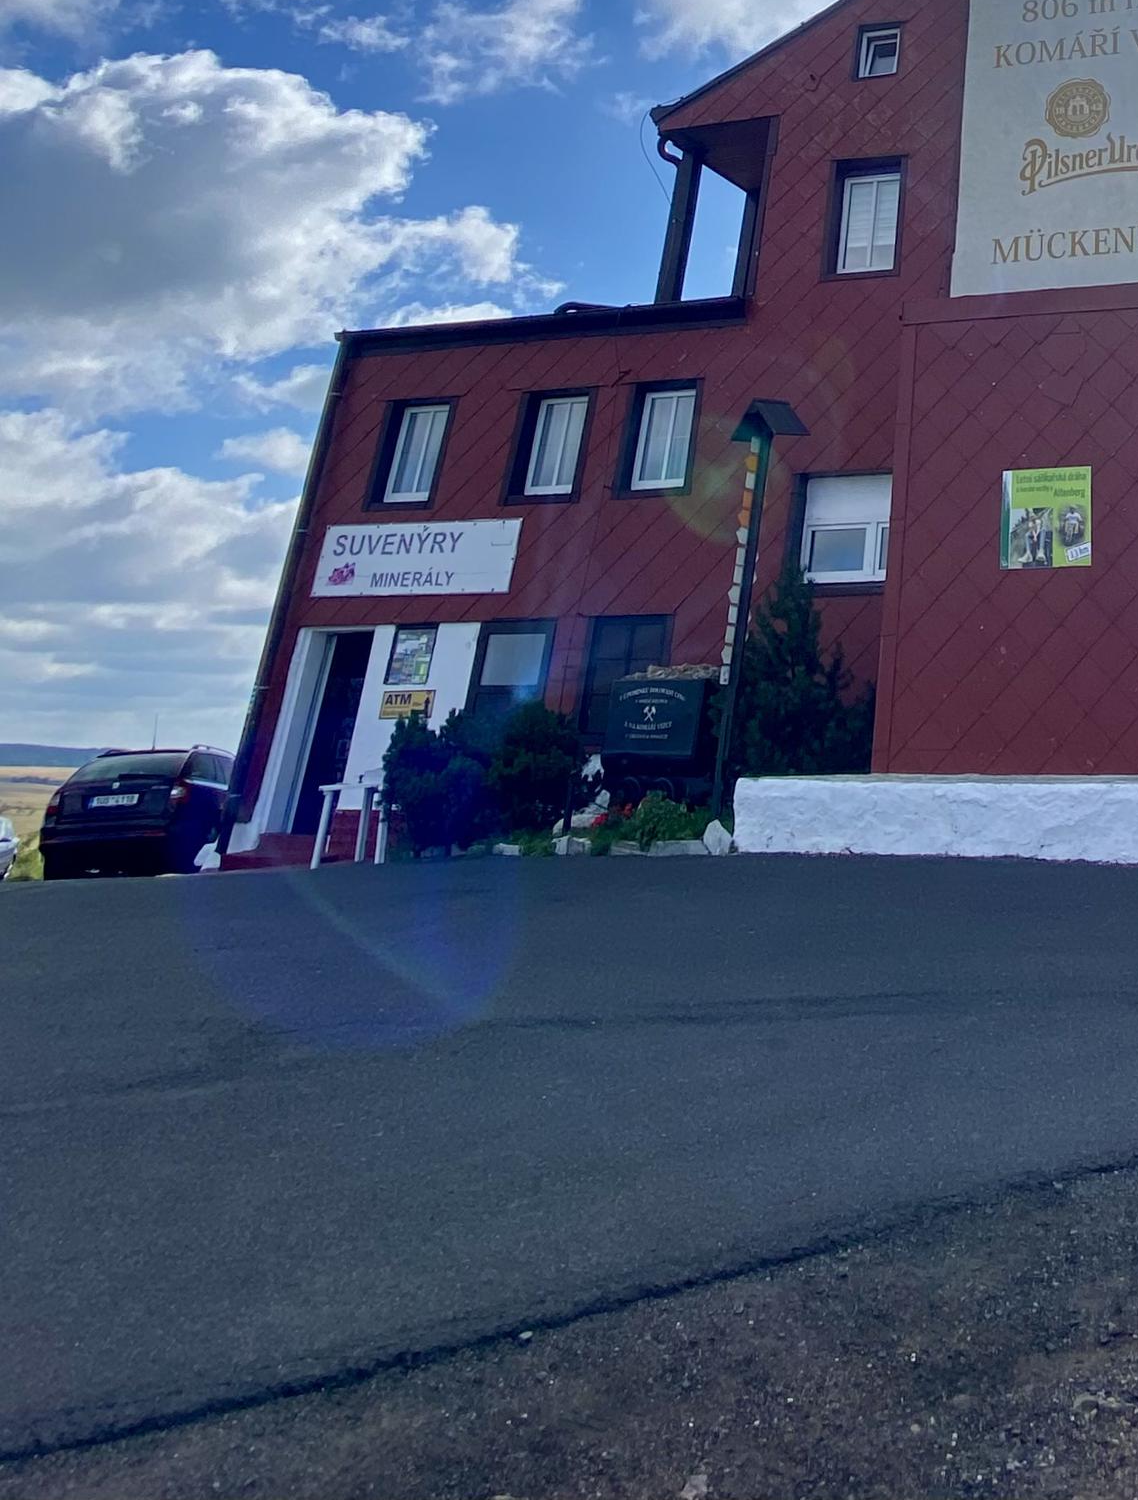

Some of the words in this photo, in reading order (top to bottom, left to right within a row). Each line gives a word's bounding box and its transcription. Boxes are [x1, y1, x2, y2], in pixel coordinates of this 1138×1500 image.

[994, 26, 1121, 69] KOMÁŘÍ
[1019, 137, 1108, 197] Pilsner
[333, 527, 463, 556] SUVENÝRY
[369, 567, 455, 588] MINERÁLY
[385, 694, 412, 706] ATM
